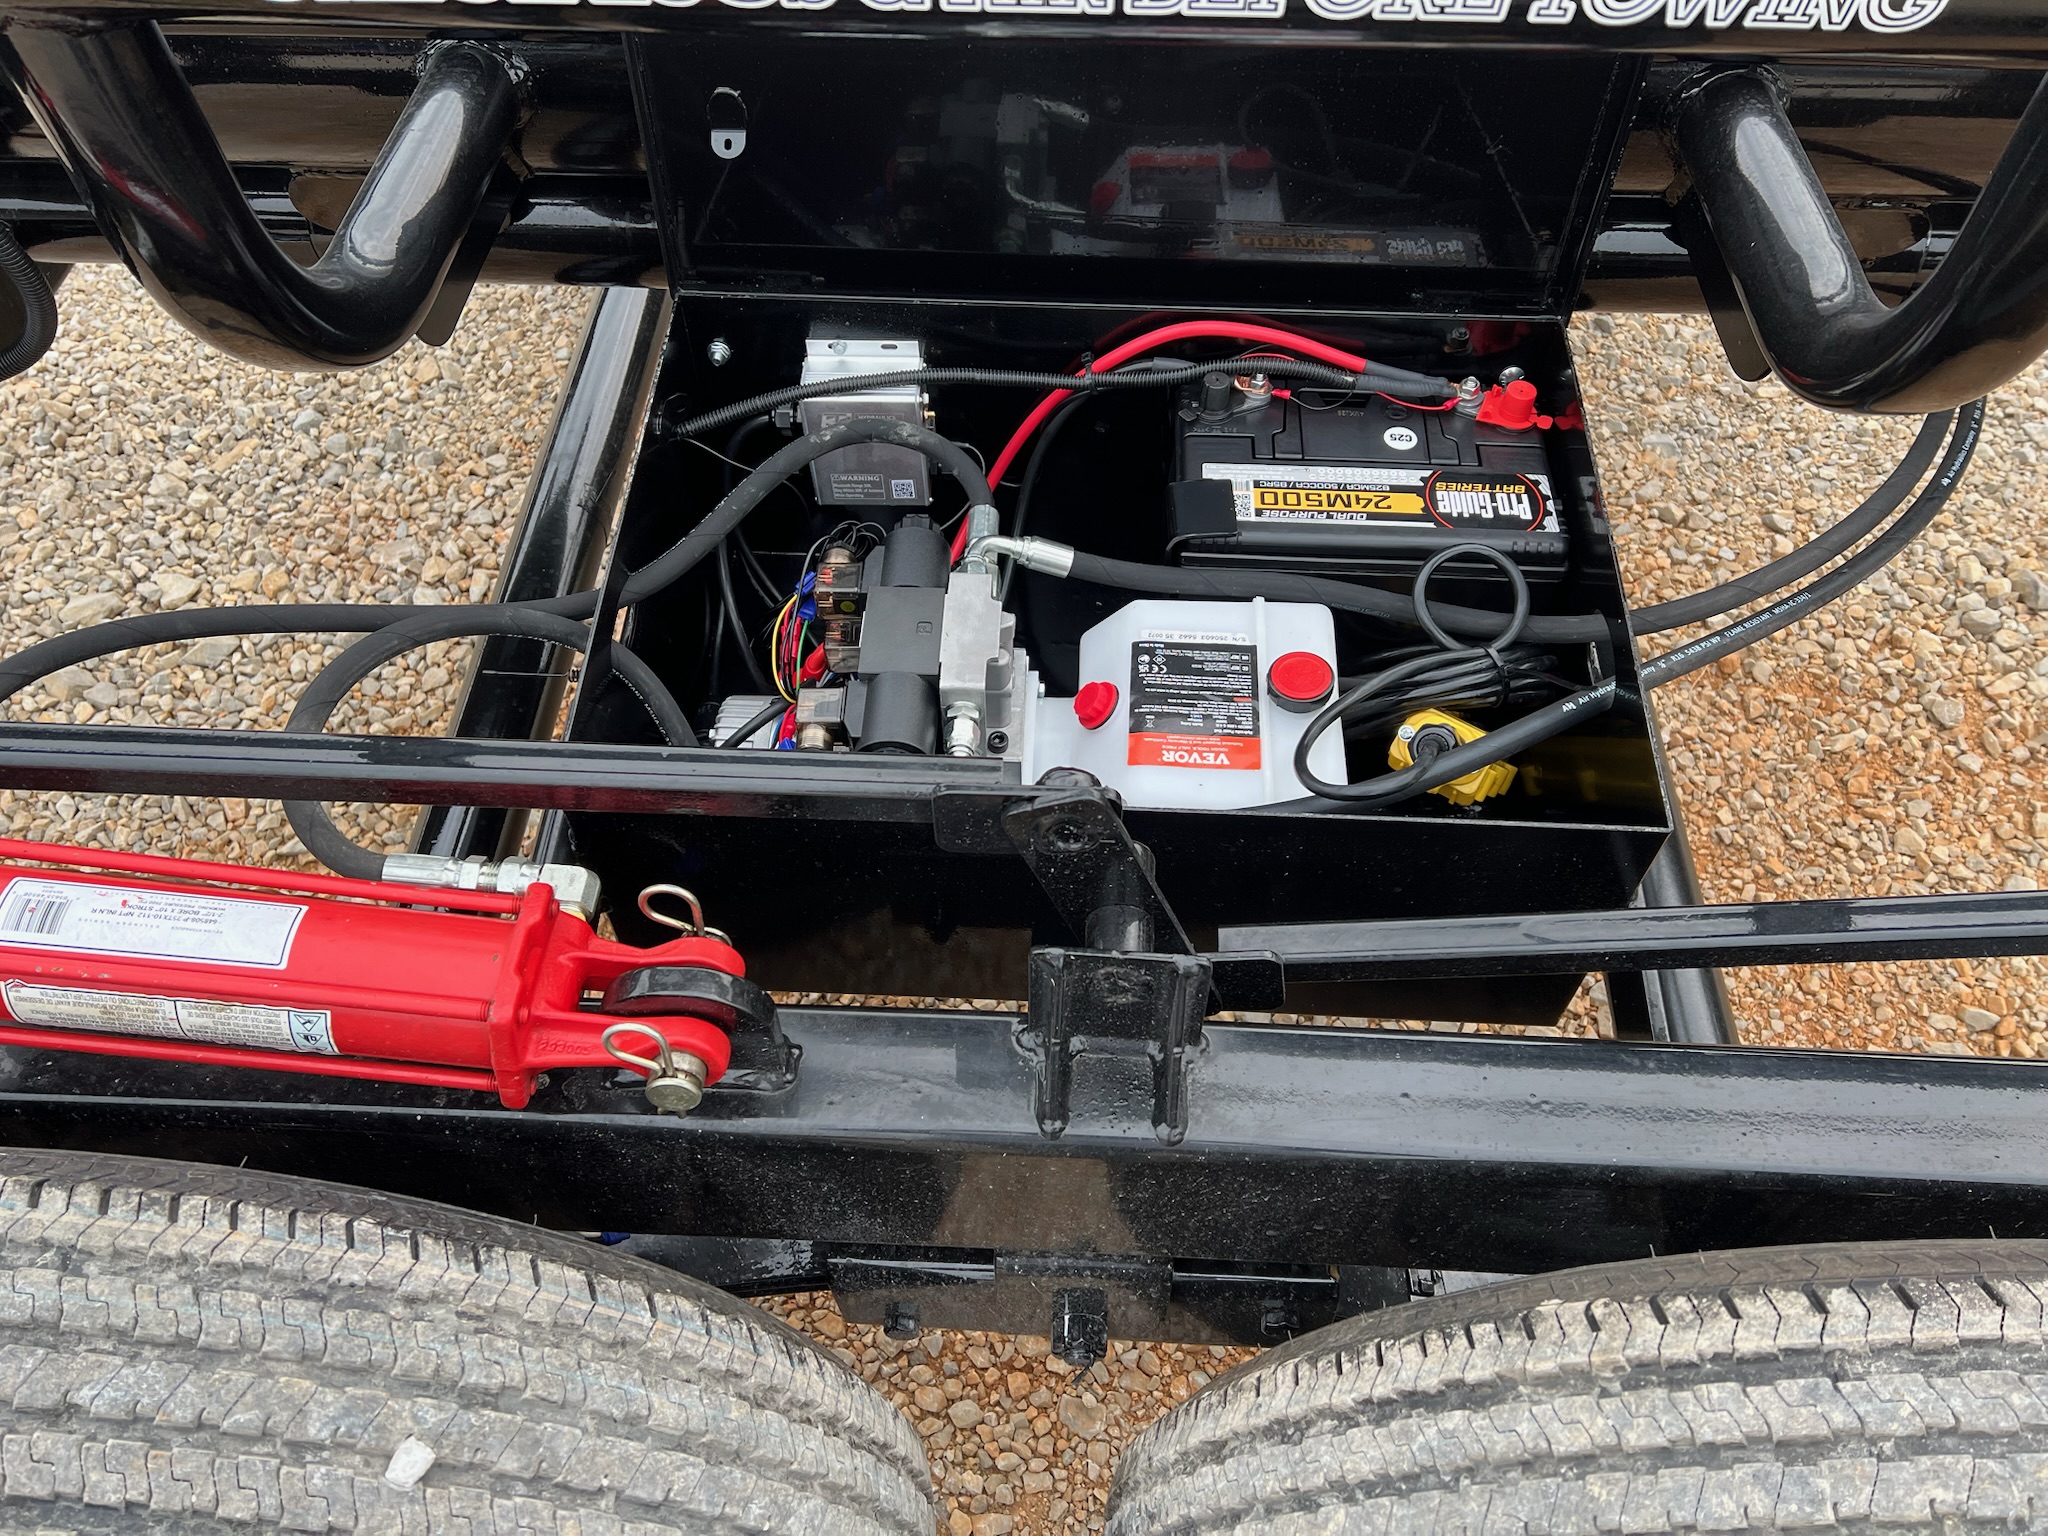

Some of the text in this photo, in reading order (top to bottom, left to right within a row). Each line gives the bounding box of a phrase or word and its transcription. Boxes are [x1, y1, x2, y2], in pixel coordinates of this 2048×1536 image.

[1389, 432, 1414, 444] C25
[1436, 482, 1526, 494] BATTERIES
[1260, 491, 1392, 510] 24M500
[1436, 491, 1533, 520] Pro-Guide
[1260, 510, 1368, 520] DUAL PURPOSE
[1724, 624, 1745, 637] FLAME
[1744, 612, 1772, 630] RESISTANT
[1162, 750, 1230, 765] VEVOR
